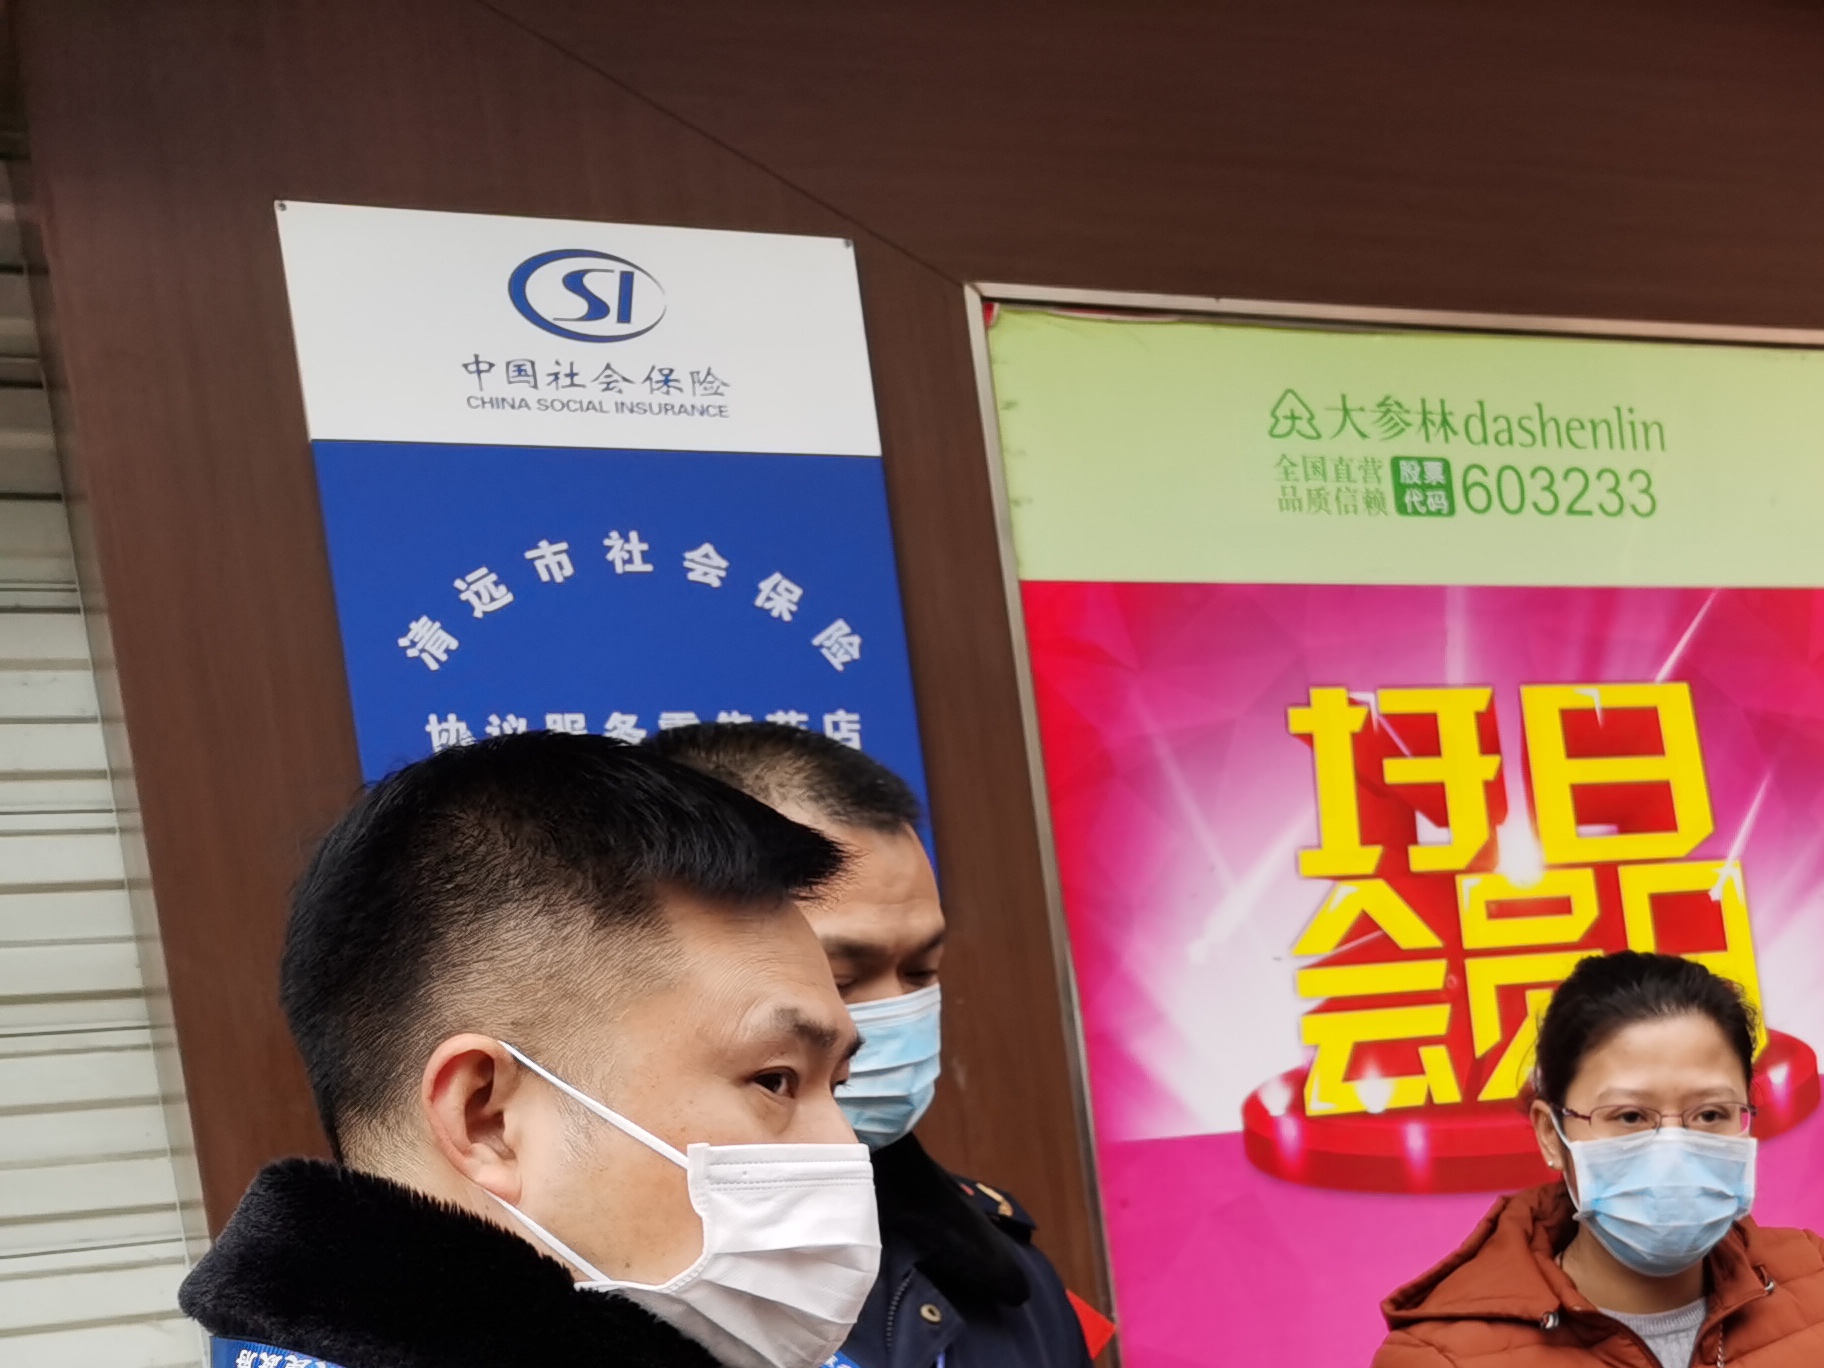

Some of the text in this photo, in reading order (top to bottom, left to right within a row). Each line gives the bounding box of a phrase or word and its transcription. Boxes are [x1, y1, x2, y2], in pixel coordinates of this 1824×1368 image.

[461, 353, 731, 397] 中国社会保险
[466, 395, 730, 418] CHINA SOCIAL INSURANCE
[1274, 454, 1384, 484] 全国直营
[1276, 485, 1389, 517] 品质信赖
[1461, 464, 1657, 518] 603233
[398, 531, 862, 671] 清远市社会保险
